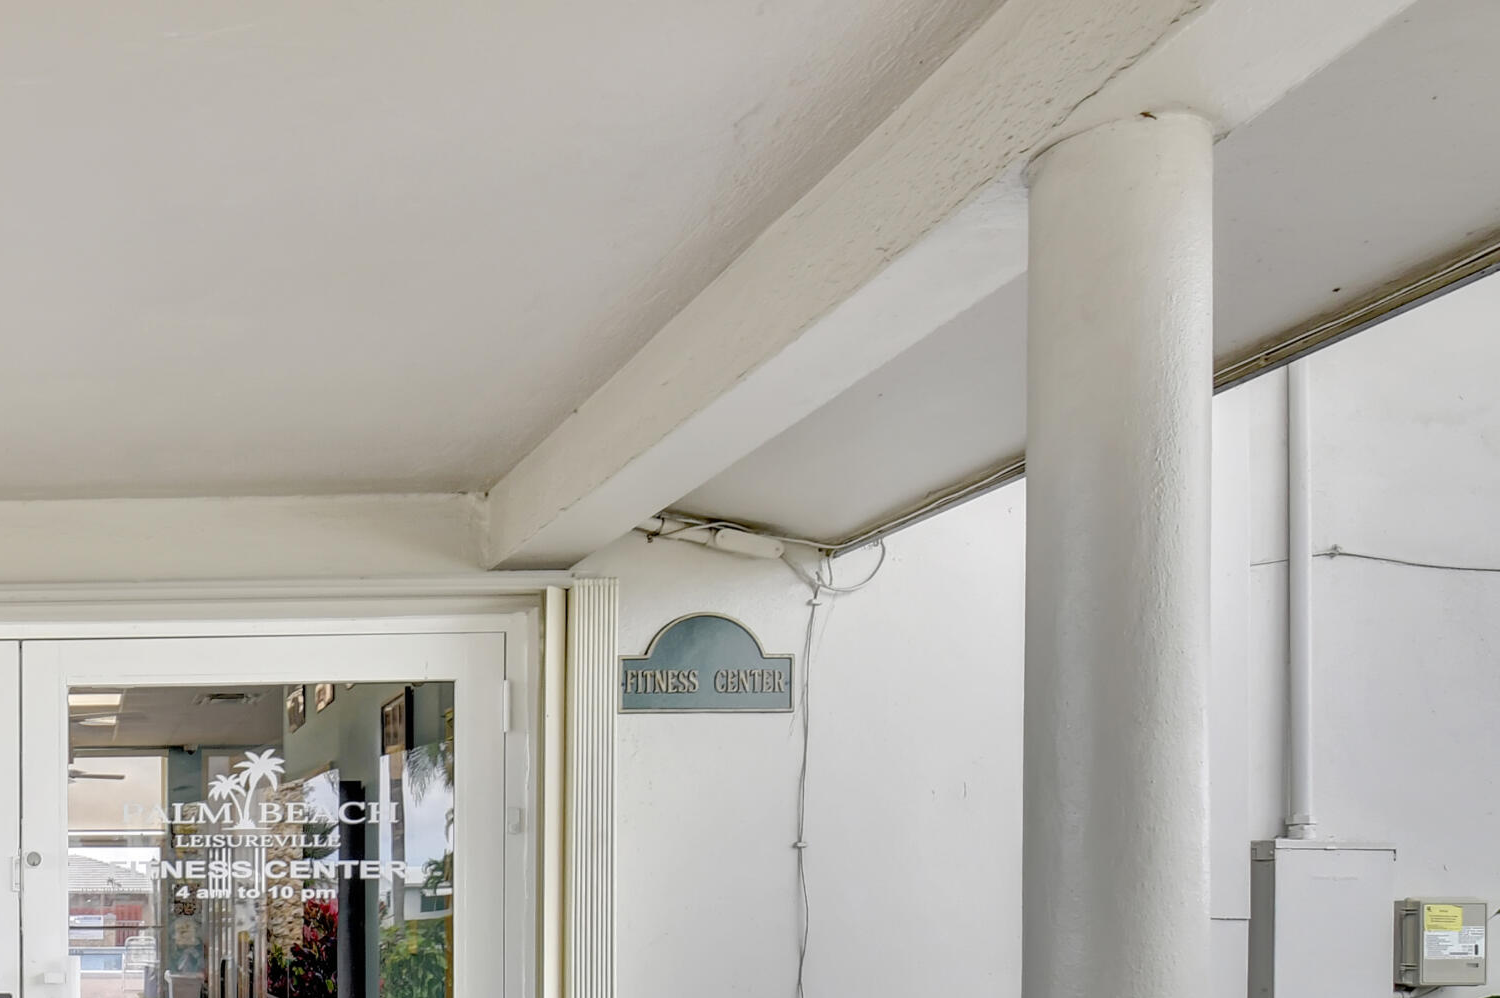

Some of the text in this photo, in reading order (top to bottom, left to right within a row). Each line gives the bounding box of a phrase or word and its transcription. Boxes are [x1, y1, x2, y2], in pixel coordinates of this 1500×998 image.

[624, 669, 786, 694] FITNESS CENTER
[121, 801, 400, 825] PALM BEACH
[174, 834, 342, 848] LEISUREVILLE
[108, 860, 408, 880] FITNESS CENTER
[175, 885, 338, 902] 4 am to 10 pm
